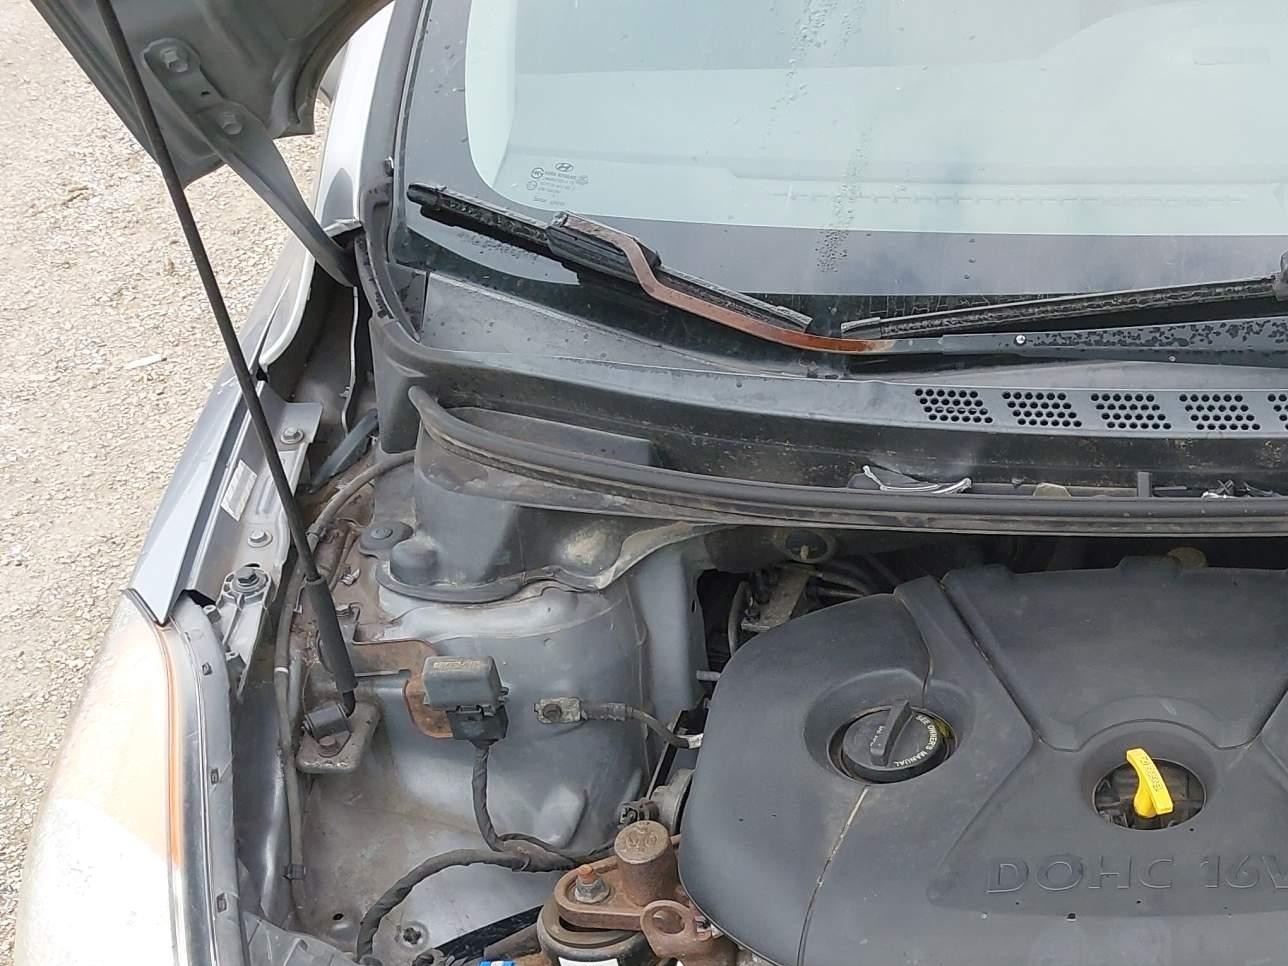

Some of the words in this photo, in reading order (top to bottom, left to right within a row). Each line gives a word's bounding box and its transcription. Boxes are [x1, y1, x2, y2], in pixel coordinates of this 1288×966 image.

[915, 714, 931, 726] SEE
[893, 749, 928, 767] MANUAL
[986, 853, 1173, 893] DOHC
